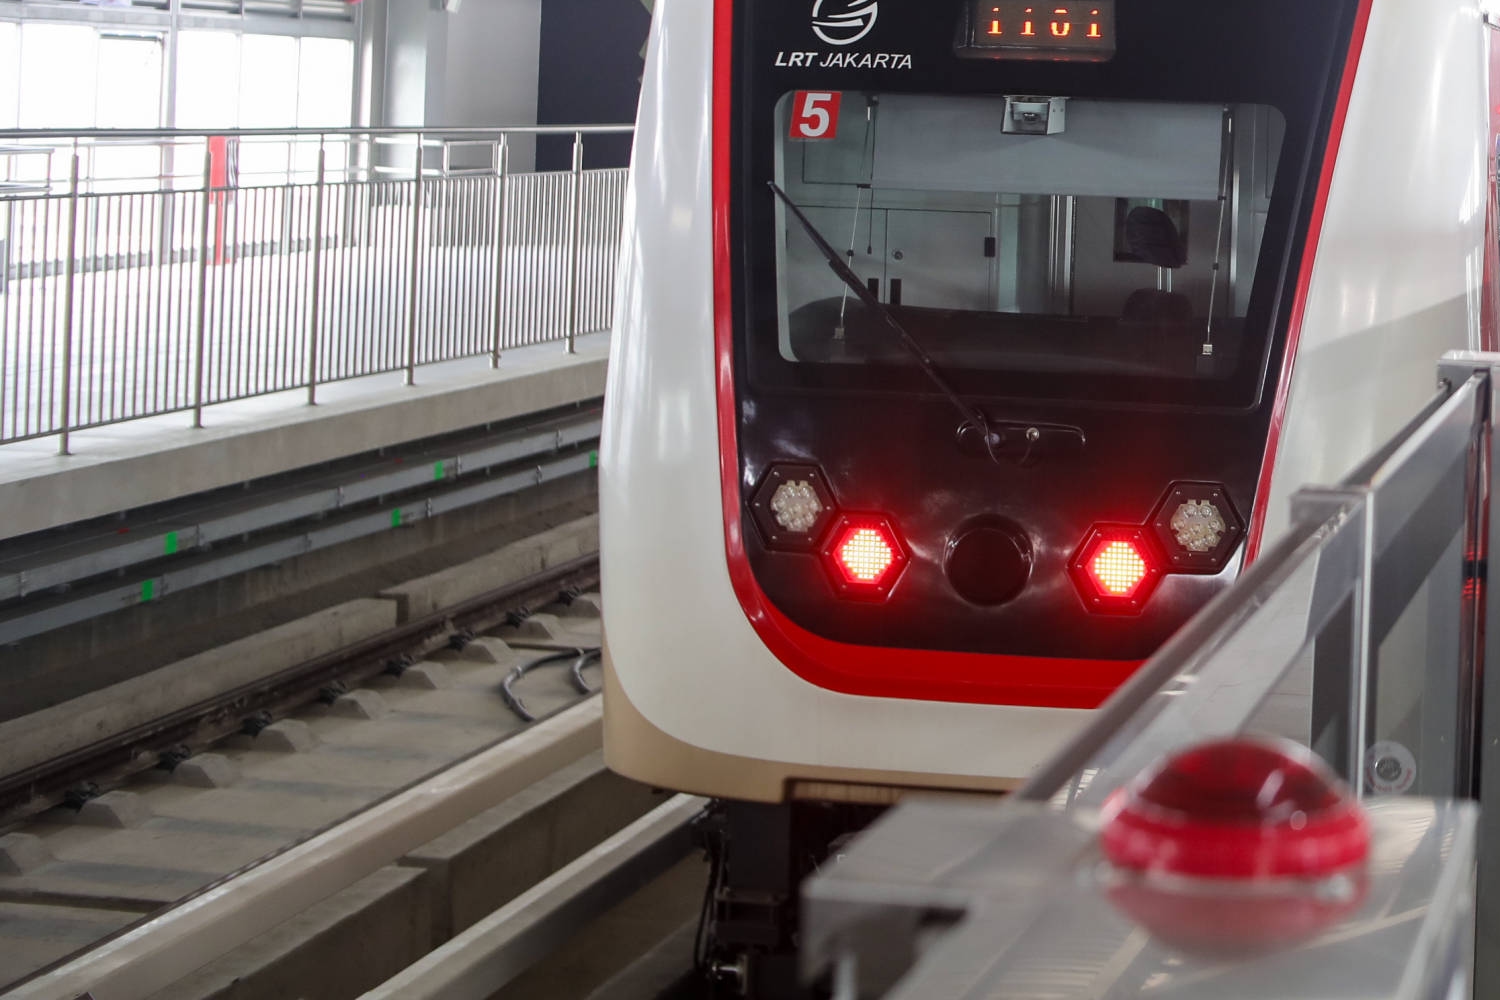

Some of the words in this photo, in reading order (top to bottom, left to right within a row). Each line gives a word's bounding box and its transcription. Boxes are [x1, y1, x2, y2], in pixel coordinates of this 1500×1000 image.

[774, 51, 818, 68] LRT
[819, 52, 912, 70] JAKARTA
[799, 92, 832, 137] 5
